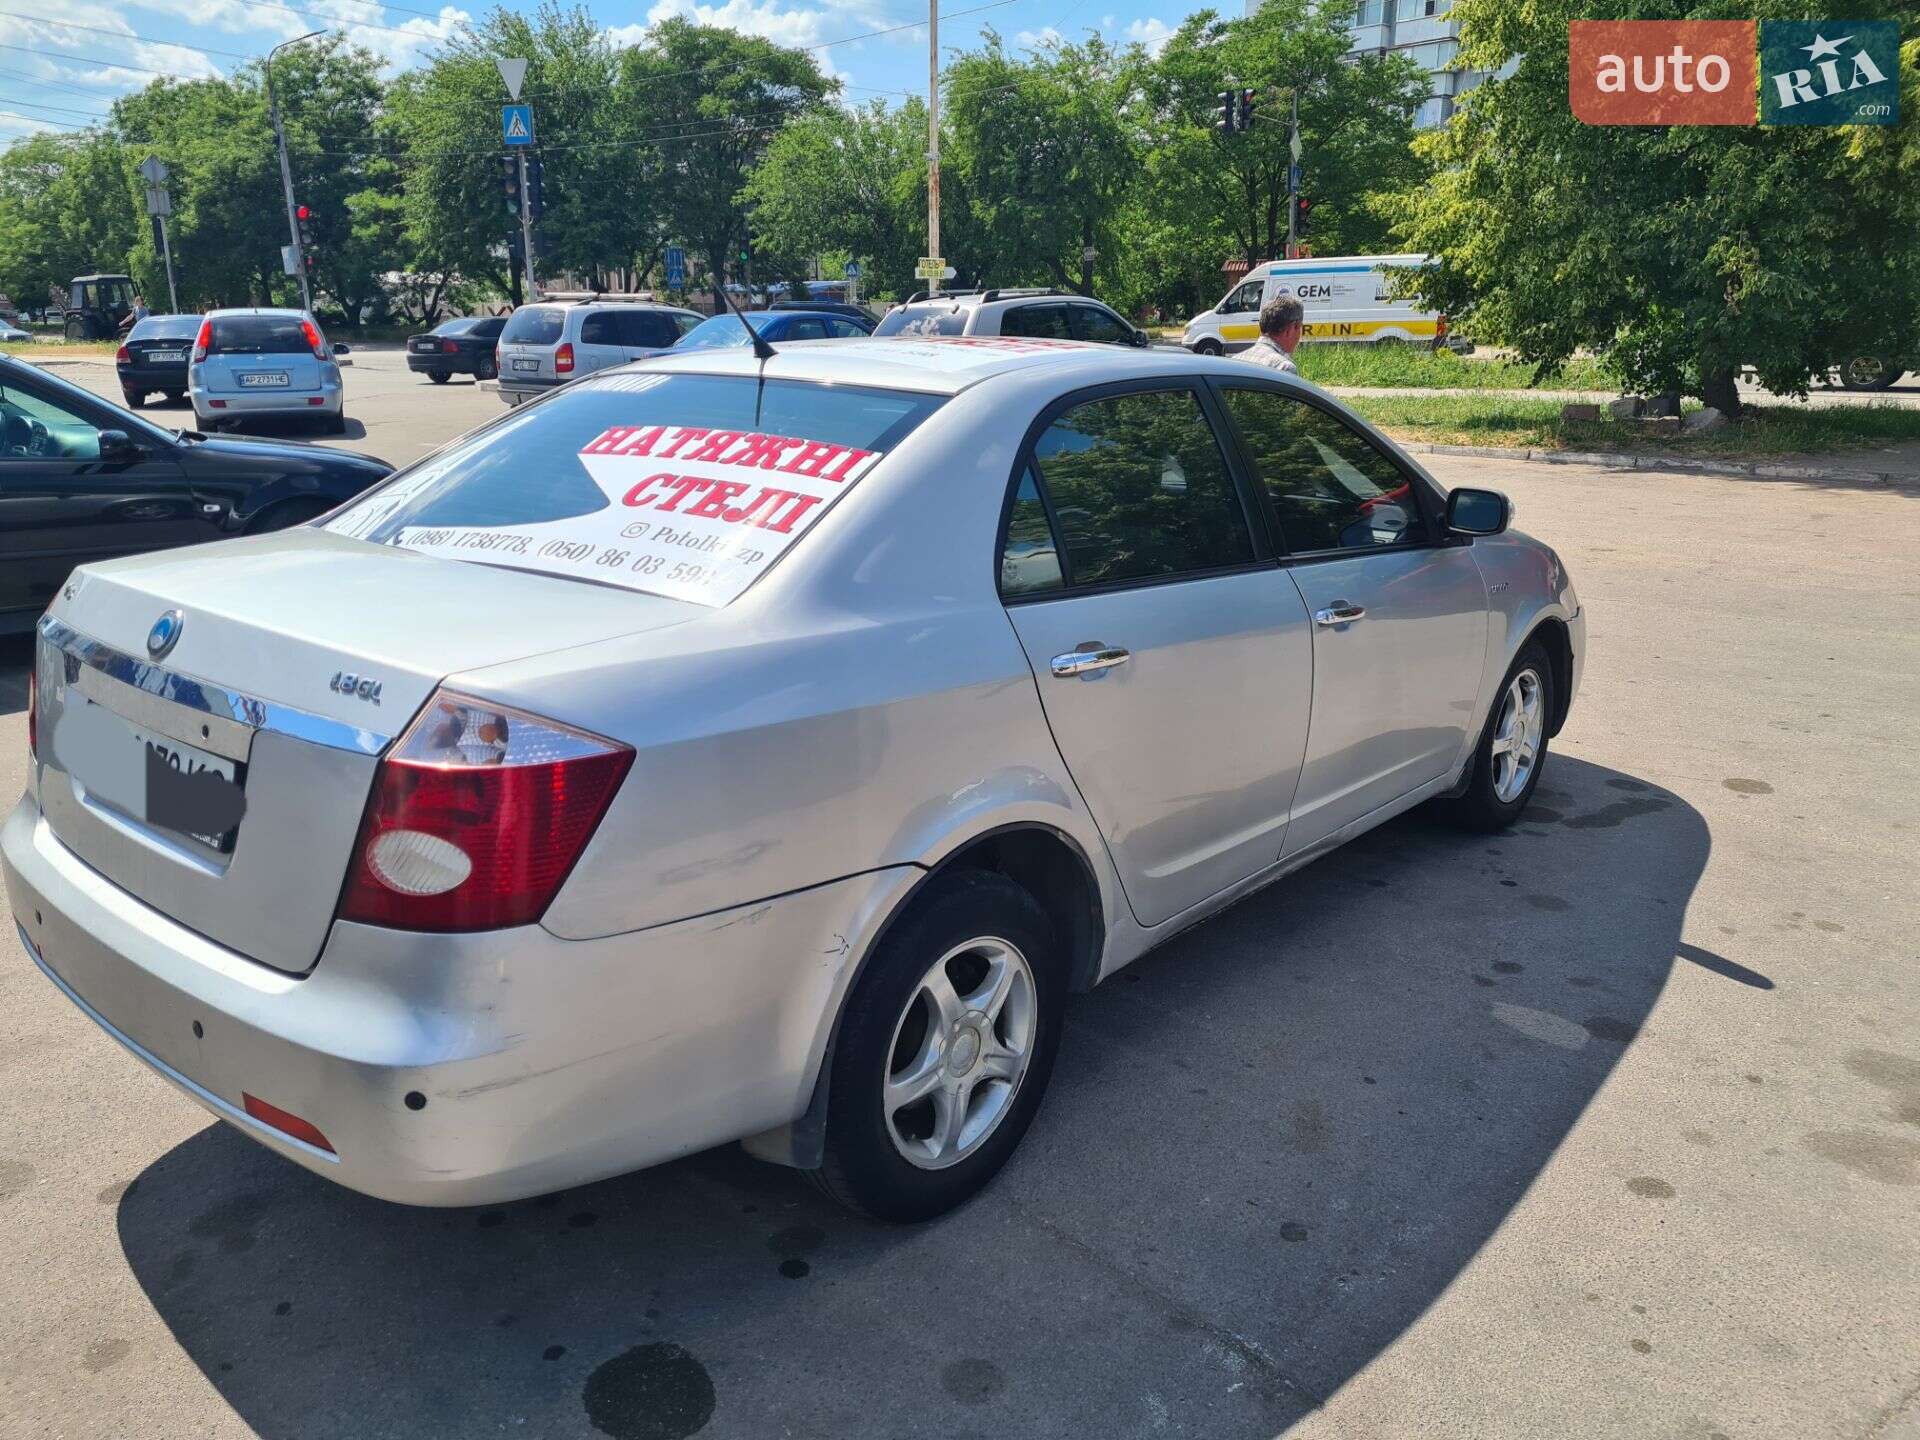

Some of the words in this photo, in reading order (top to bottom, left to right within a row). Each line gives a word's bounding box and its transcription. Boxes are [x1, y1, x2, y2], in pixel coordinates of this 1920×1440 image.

[1297, 284, 1332, 298] GEM
[581, 425, 873, 483] НАТЯЖНІ
[622, 472, 824, 534] СТЕЛІ
[406, 529, 456, 546] (098)
[453, 531, 534, 555] 1738778,
[537, 540, 597, 563] (050)
[596, 549, 630, 567] 86
[631, 555, 666, 575] 03
